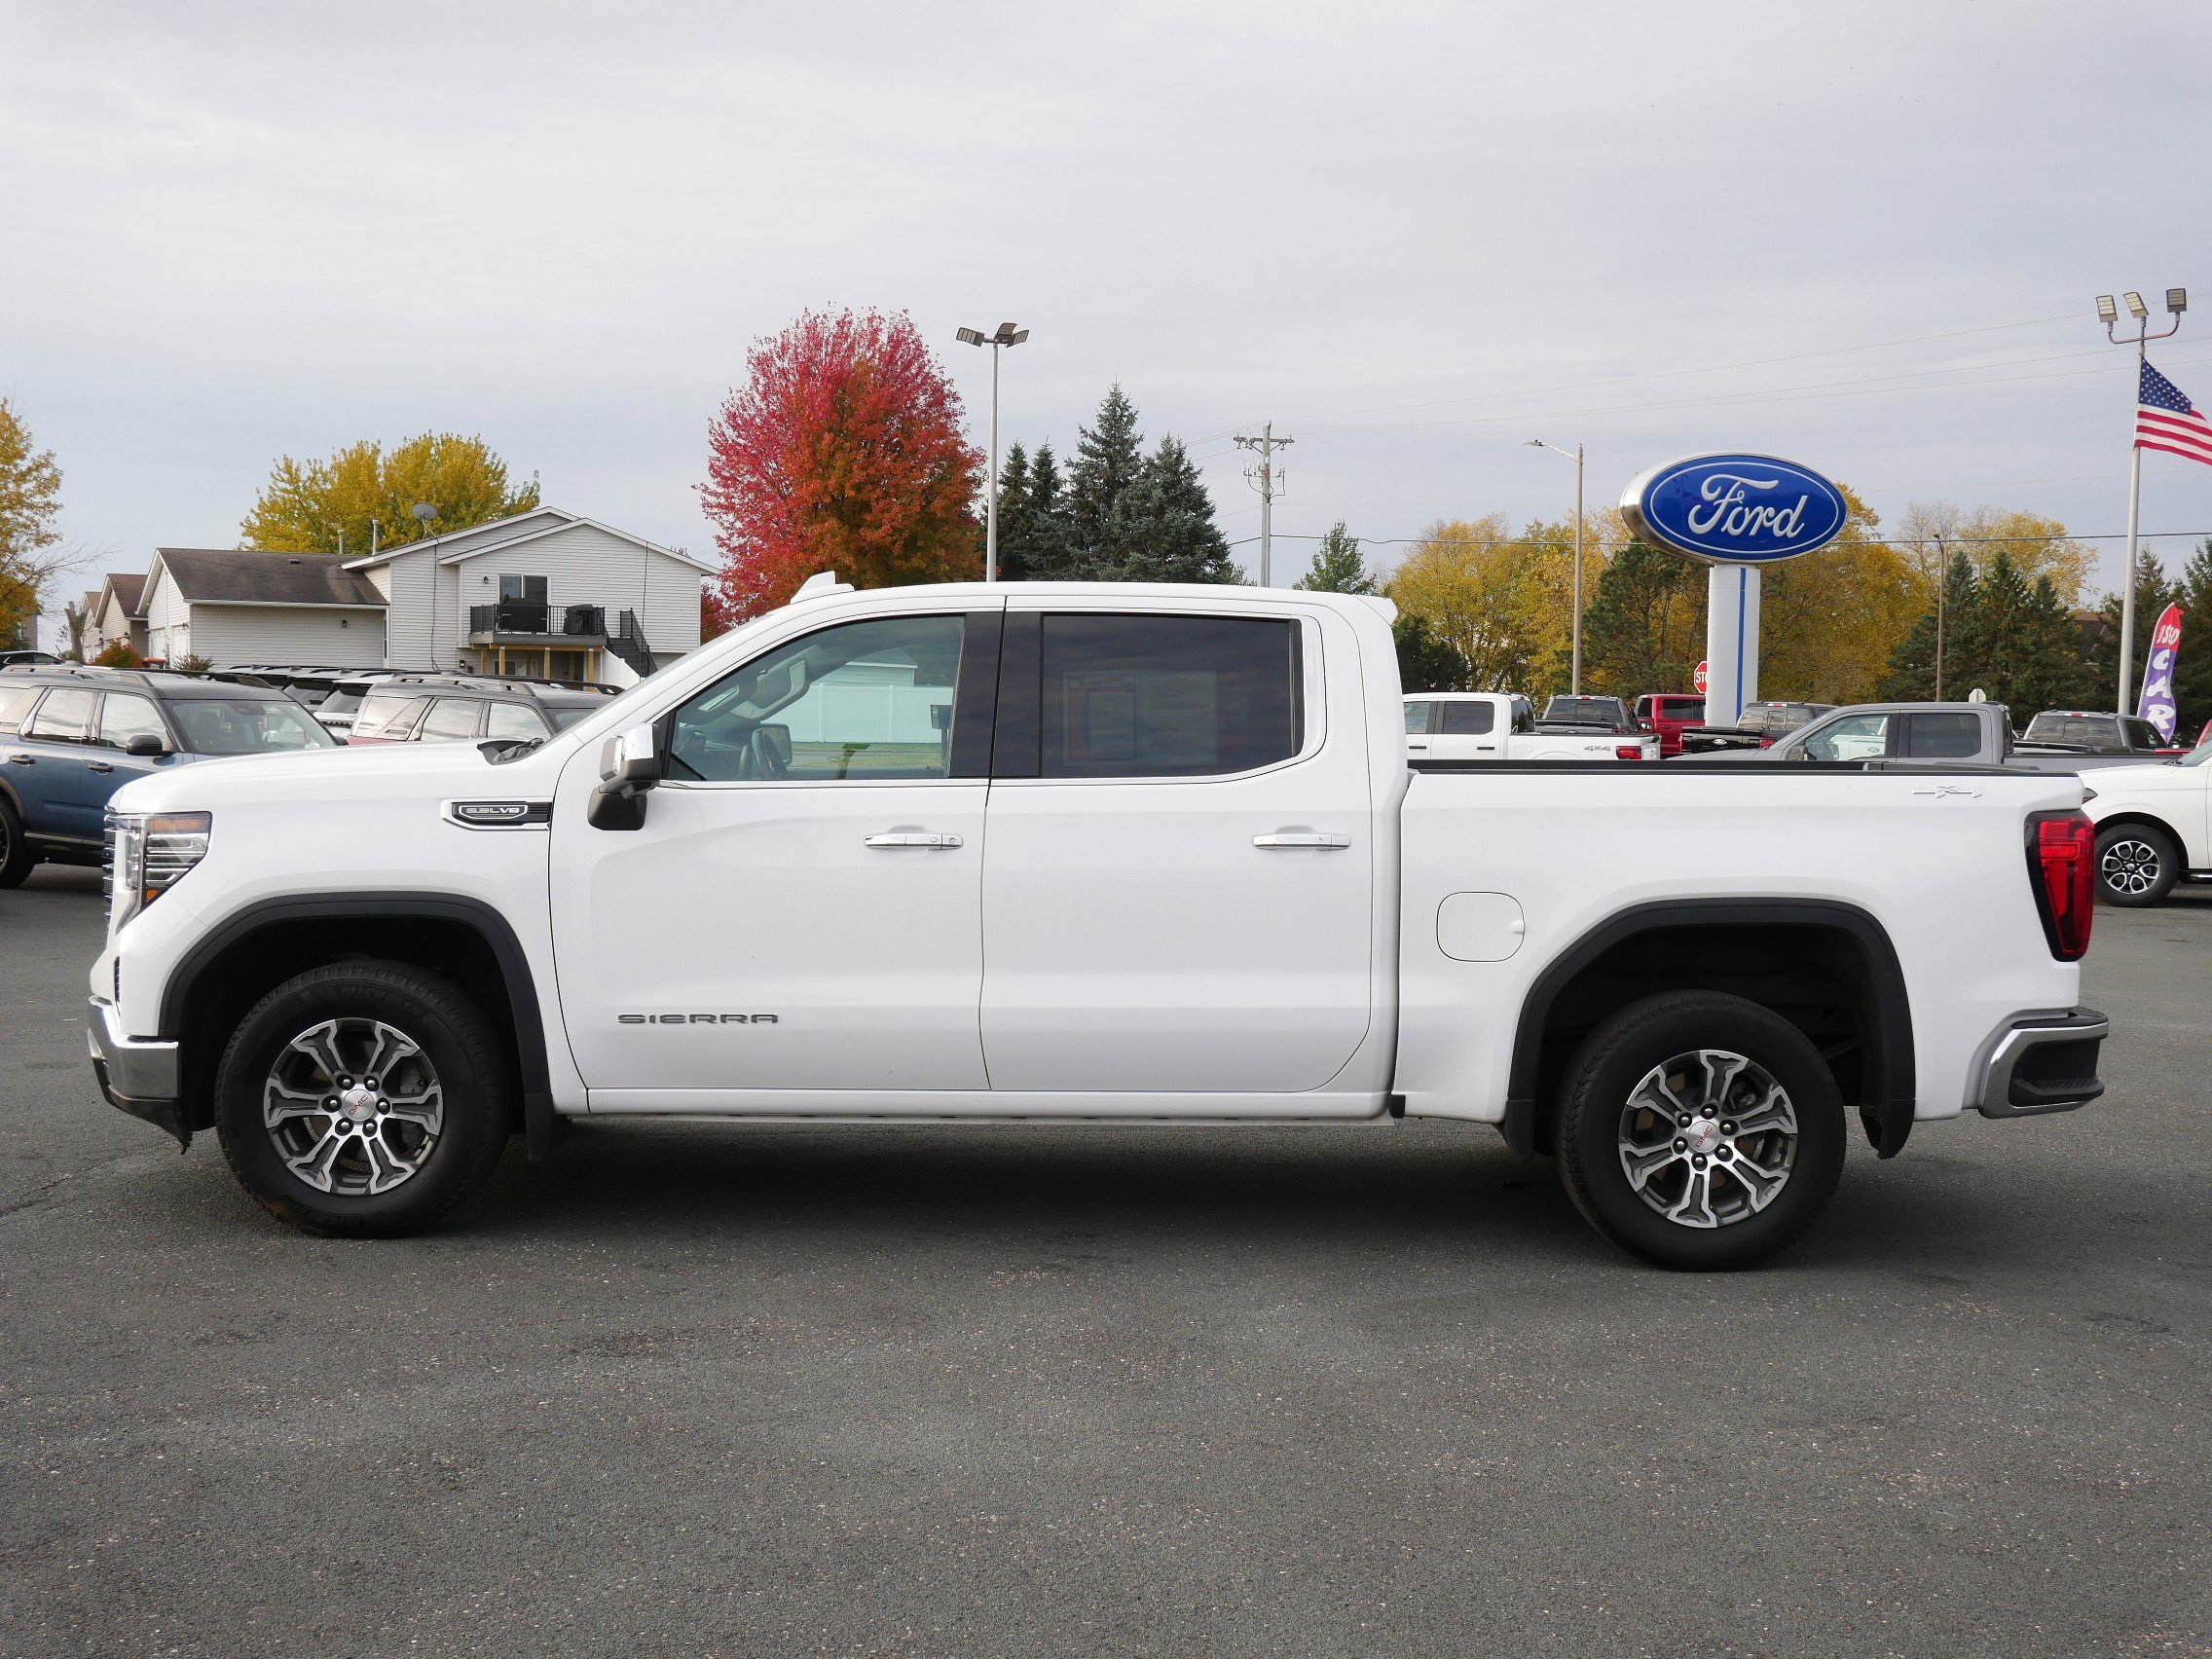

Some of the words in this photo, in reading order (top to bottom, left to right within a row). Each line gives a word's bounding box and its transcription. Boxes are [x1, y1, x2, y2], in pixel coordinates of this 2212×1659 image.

[1688, 474, 1808, 538] Ford
[1696, 672, 1707, 683] ST
[2146, 649, 2175, 740] CAR
[618, 1014, 778, 1023] SIERRA
[349, 1093, 369, 1116] GMC
[1695, 1124, 1714, 1148] GMC
